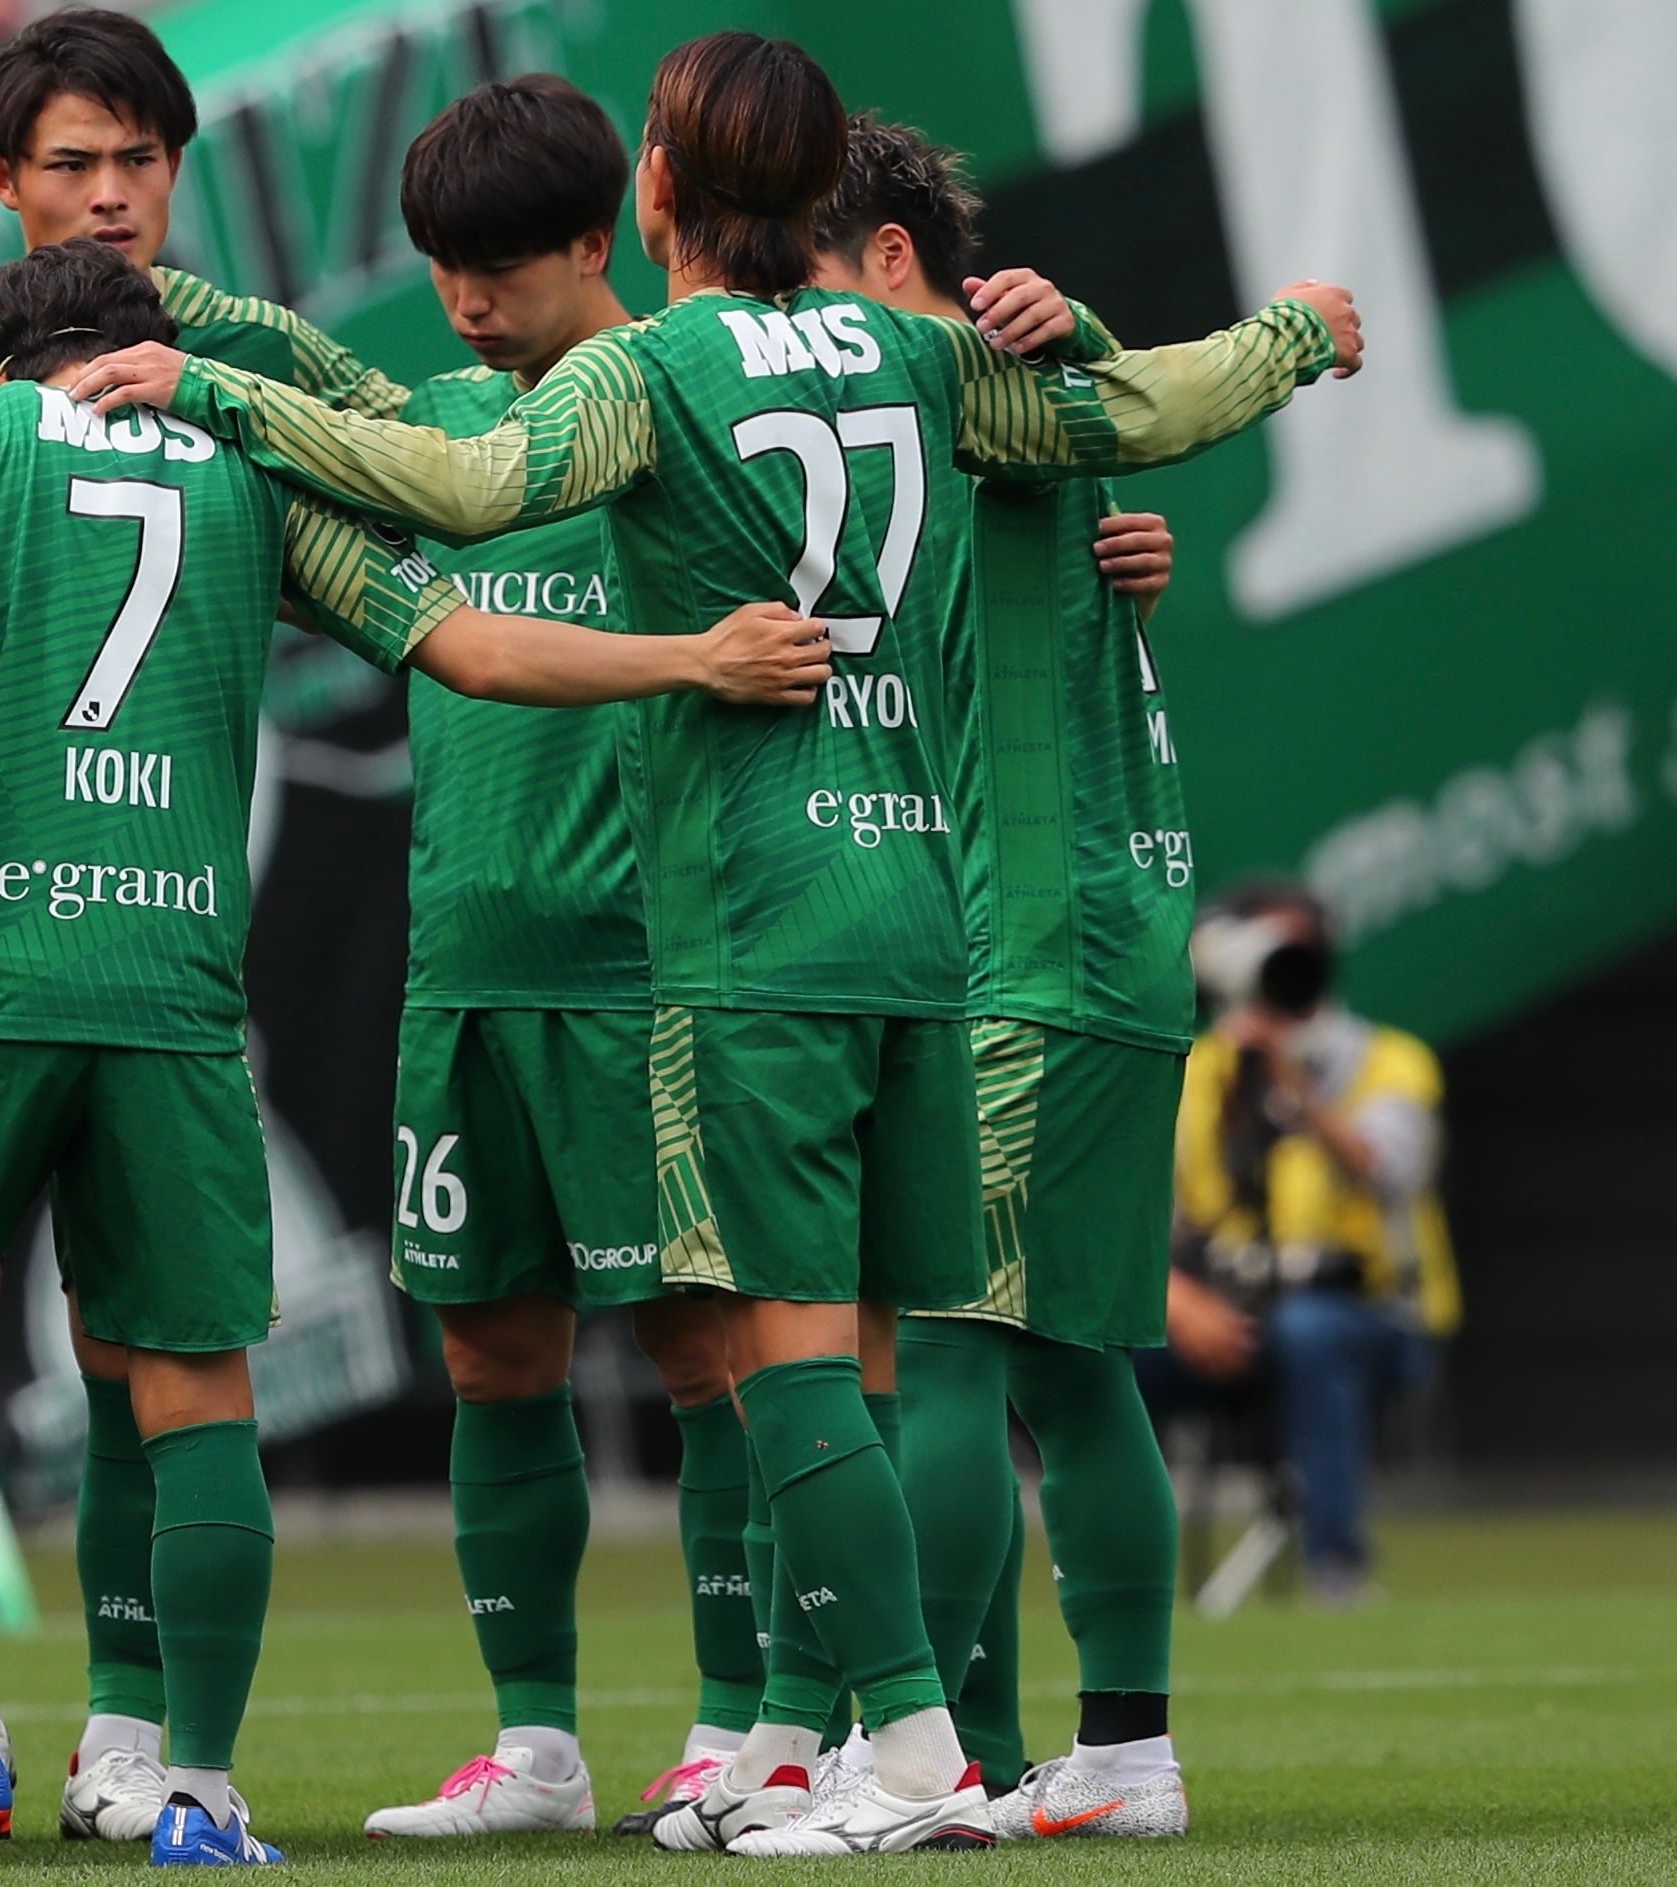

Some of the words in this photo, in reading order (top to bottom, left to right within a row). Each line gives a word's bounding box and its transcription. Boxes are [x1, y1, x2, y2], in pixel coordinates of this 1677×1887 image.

[36, 386, 216, 463] MJS
[731, 402, 926, 658] 27
[60, 474, 187, 736] 7
[65, 746, 172, 809] KOKI
[397, 1125, 467, 1233] 26
[404, 1247, 459, 1270] ATHLETA
